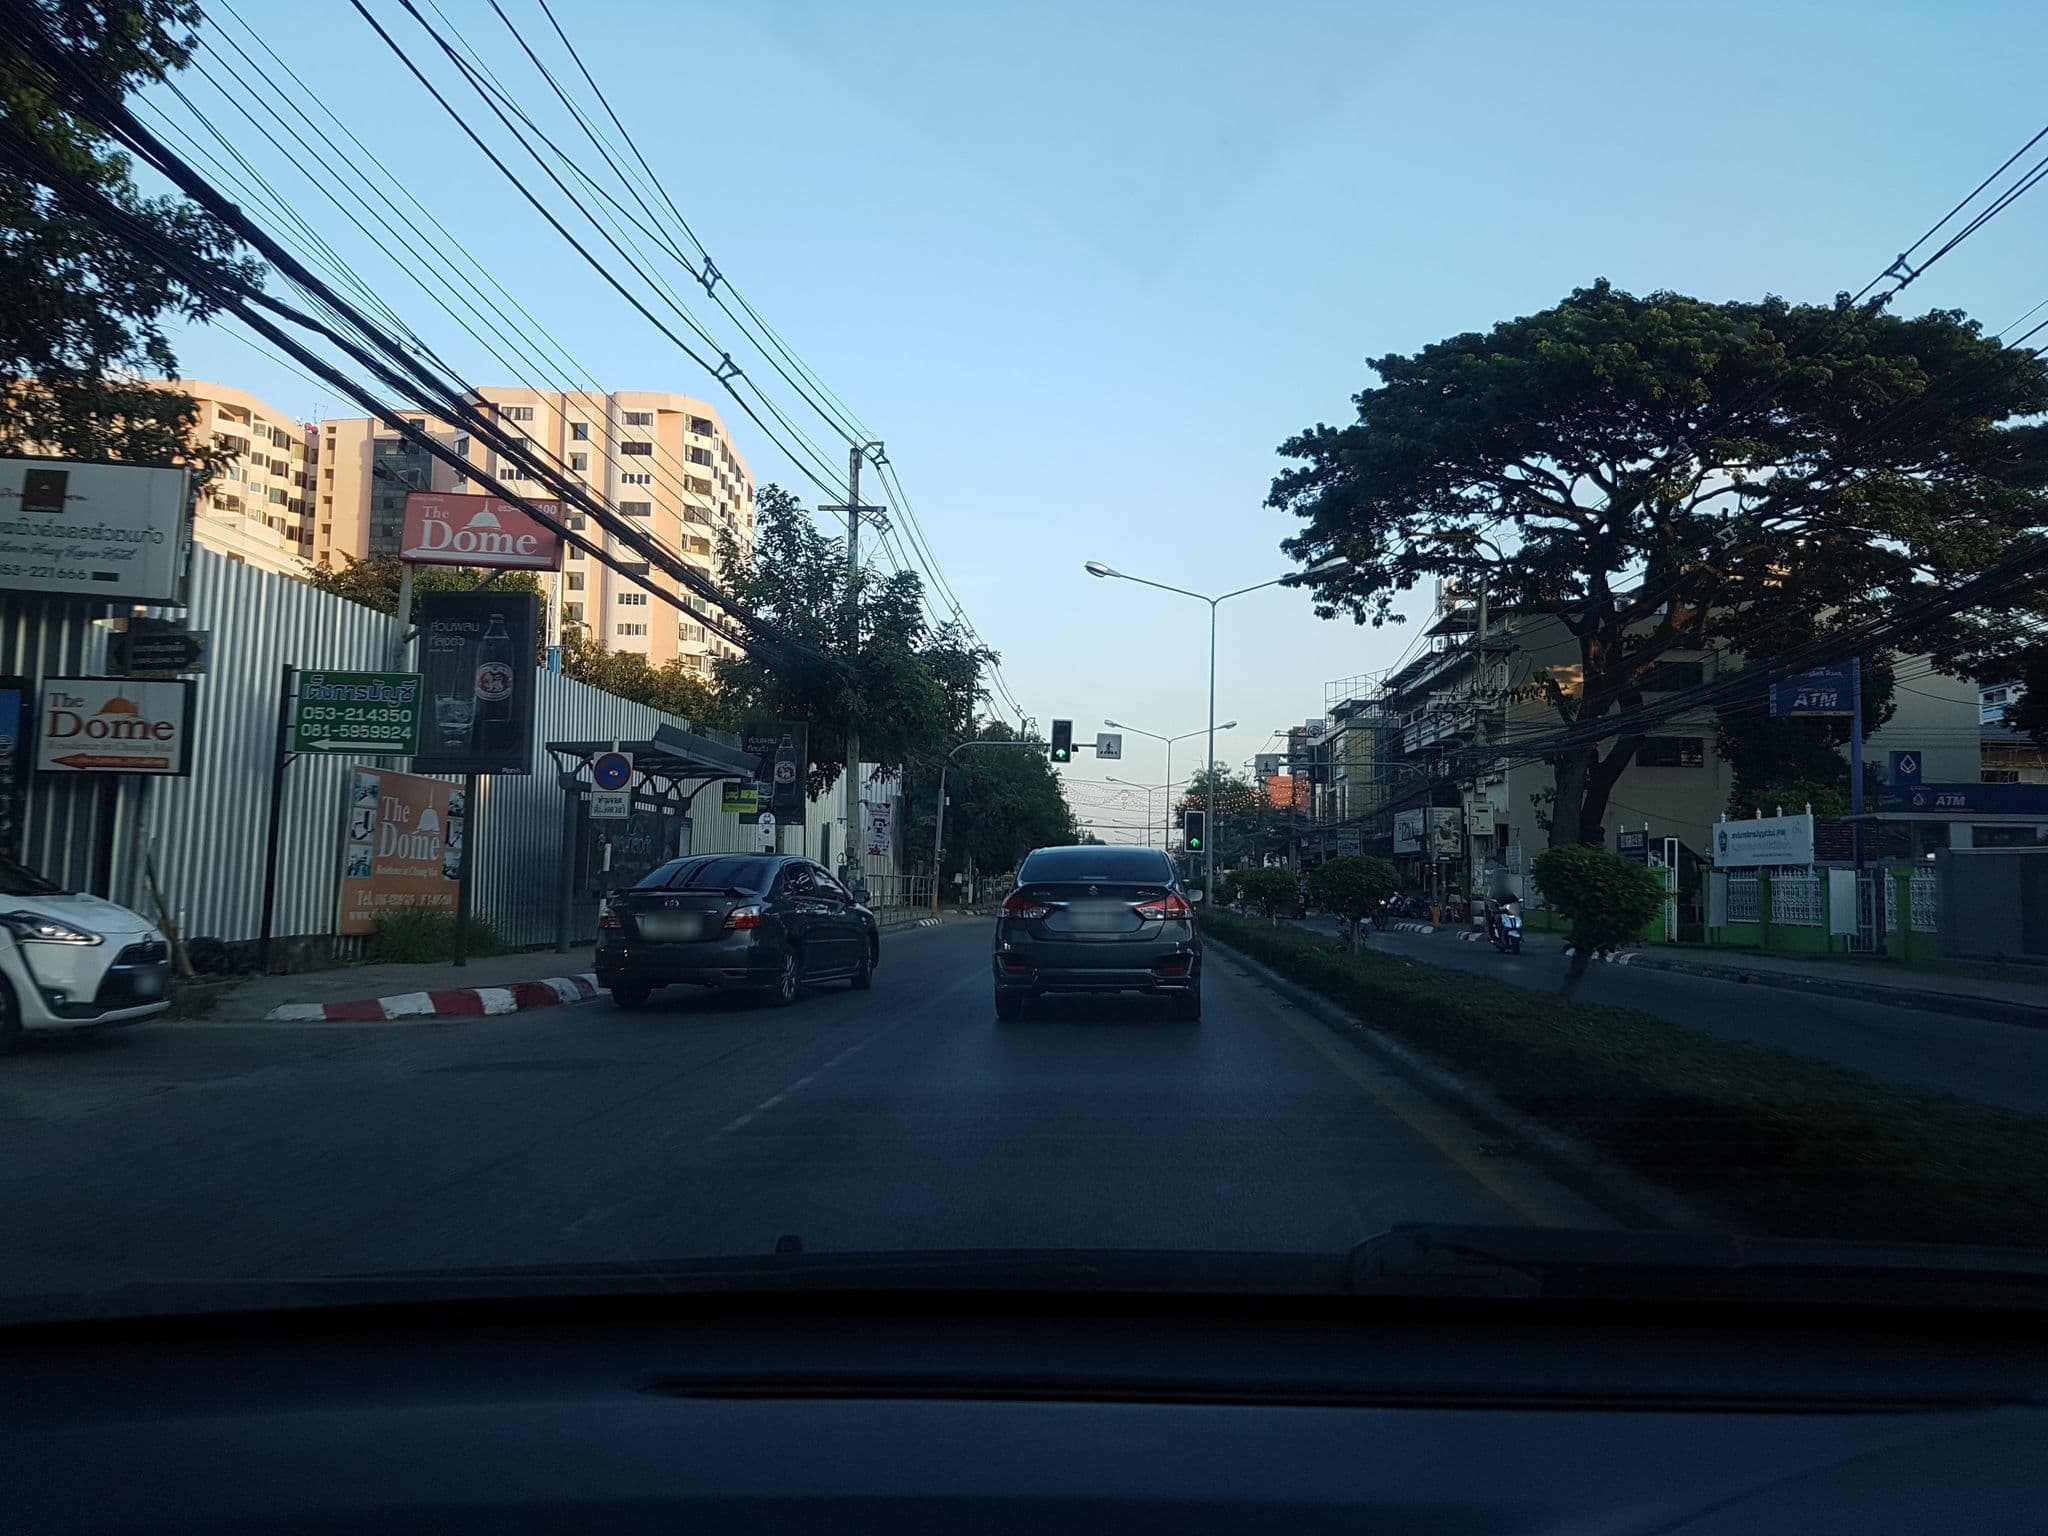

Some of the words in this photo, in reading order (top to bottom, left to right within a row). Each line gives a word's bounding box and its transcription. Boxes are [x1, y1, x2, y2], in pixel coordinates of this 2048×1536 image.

[423, 505, 449, 518] The
[419, 519, 538, 555] Dome
[48, 692, 85, 708] The
[1792, 692, 1838, 707] ATM
[302, 706, 412, 723] 053-214350
[47, 710, 175, 741] Dome
[300, 723, 412, 739] 081-5959924
[1936, 796, 1966, 806] ATM
[382, 796, 410, 823] The
[377, 821, 441, 861] Dome
